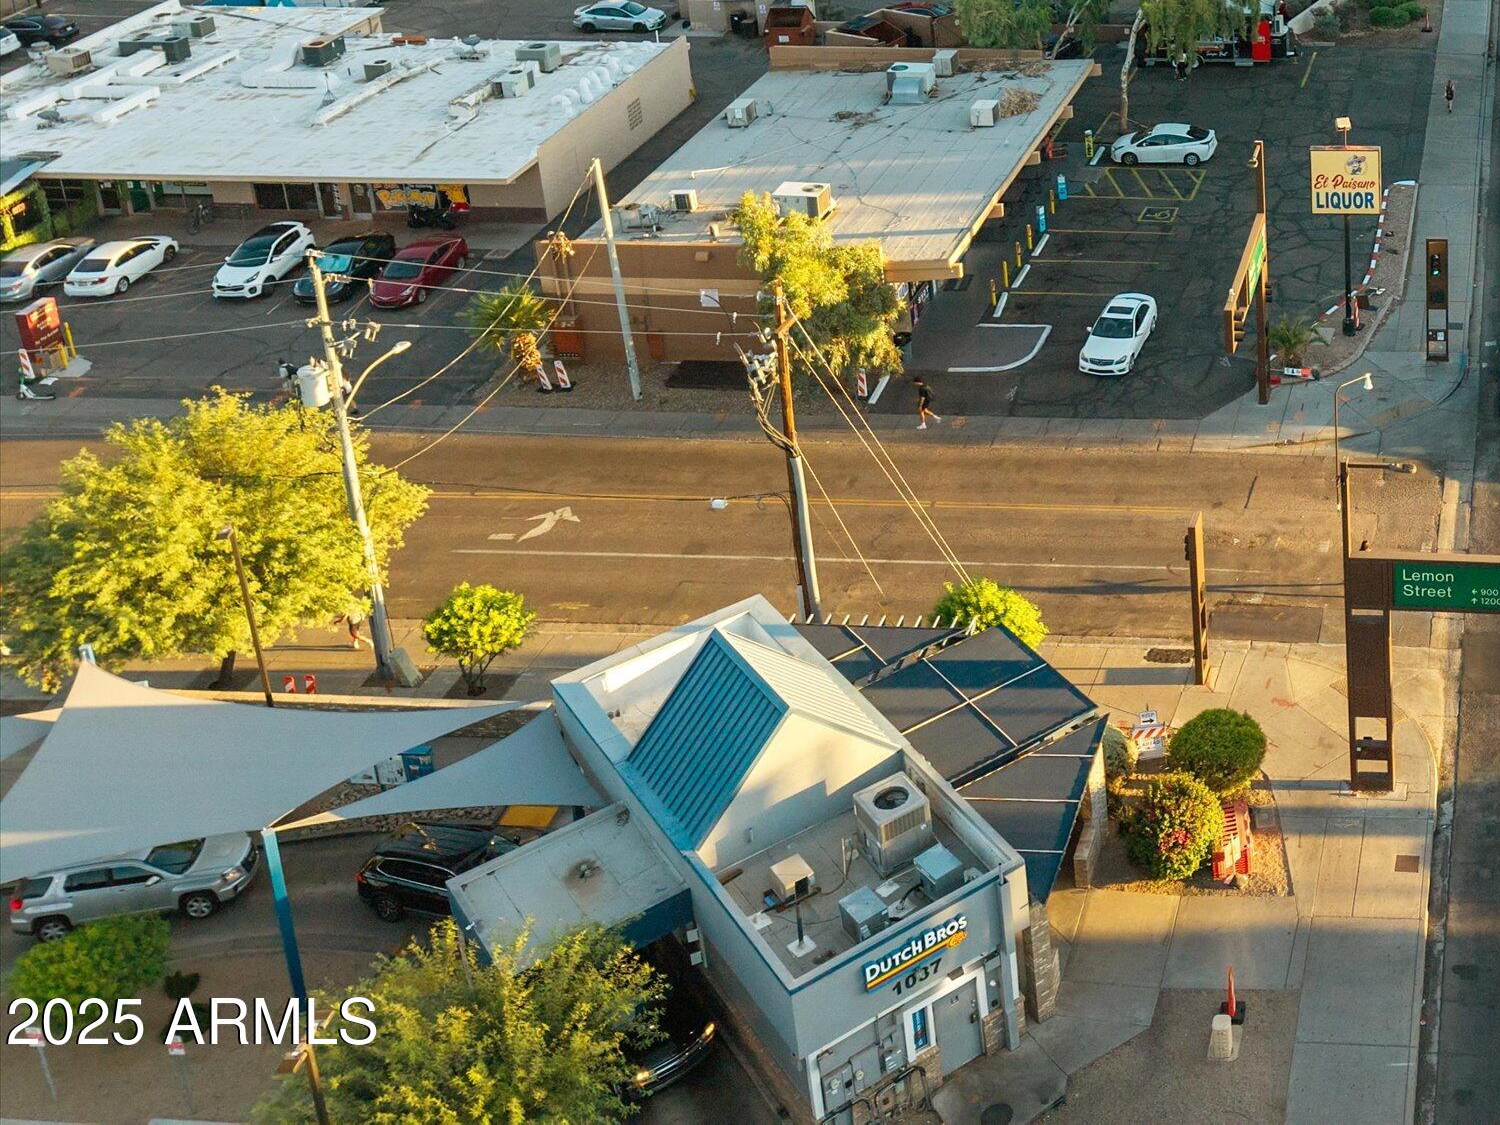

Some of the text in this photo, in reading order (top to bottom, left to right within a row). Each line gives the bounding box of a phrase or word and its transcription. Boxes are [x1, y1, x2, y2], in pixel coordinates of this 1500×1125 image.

[1314, 174, 1376, 189] El Paisano
[1316, 192, 1375, 209] LIQUOR
[1402, 569, 1454, 582] Lemon
[1403, 585, 1452, 597] Street
[1480, 589, 1499, 597] 900
[865, 915, 968, 982] DUTCH BROS
[892, 957, 942, 995] 1037
